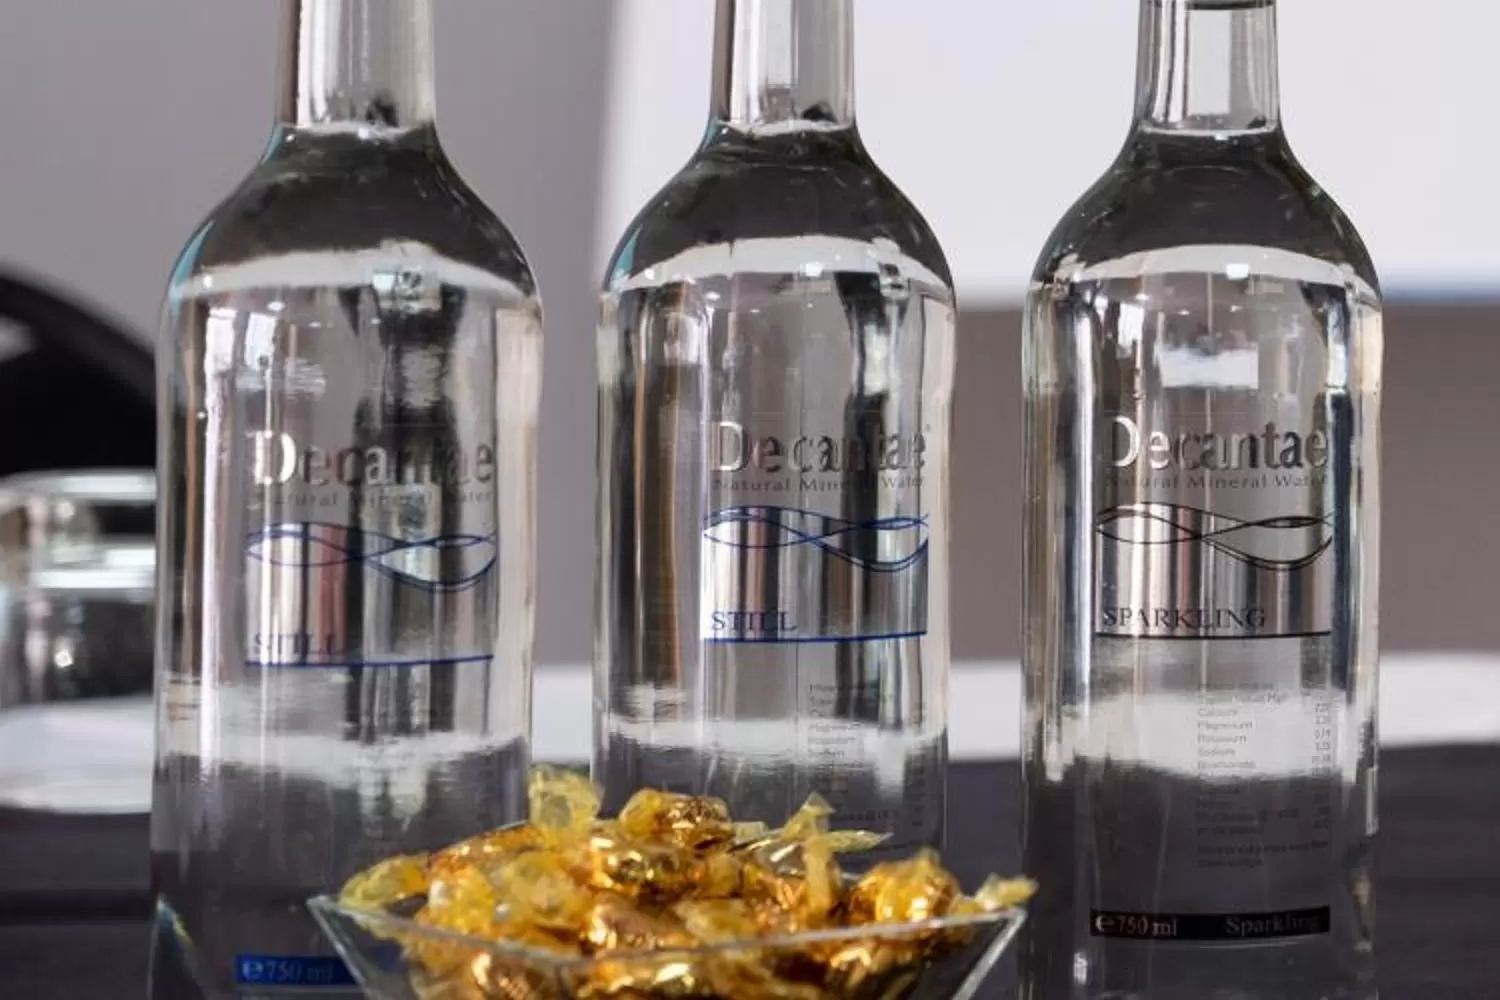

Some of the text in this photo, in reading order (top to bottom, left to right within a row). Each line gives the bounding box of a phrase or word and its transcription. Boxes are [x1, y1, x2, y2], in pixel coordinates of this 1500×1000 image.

[1108, 416, 1328, 470] Decantae
[1106, 474, 1180, 491] Naural
[1186, 474, 1268, 491] Mineral
[711, 610, 798, 632] STILL
[1102, 606, 1266, 631] SPARKLING
